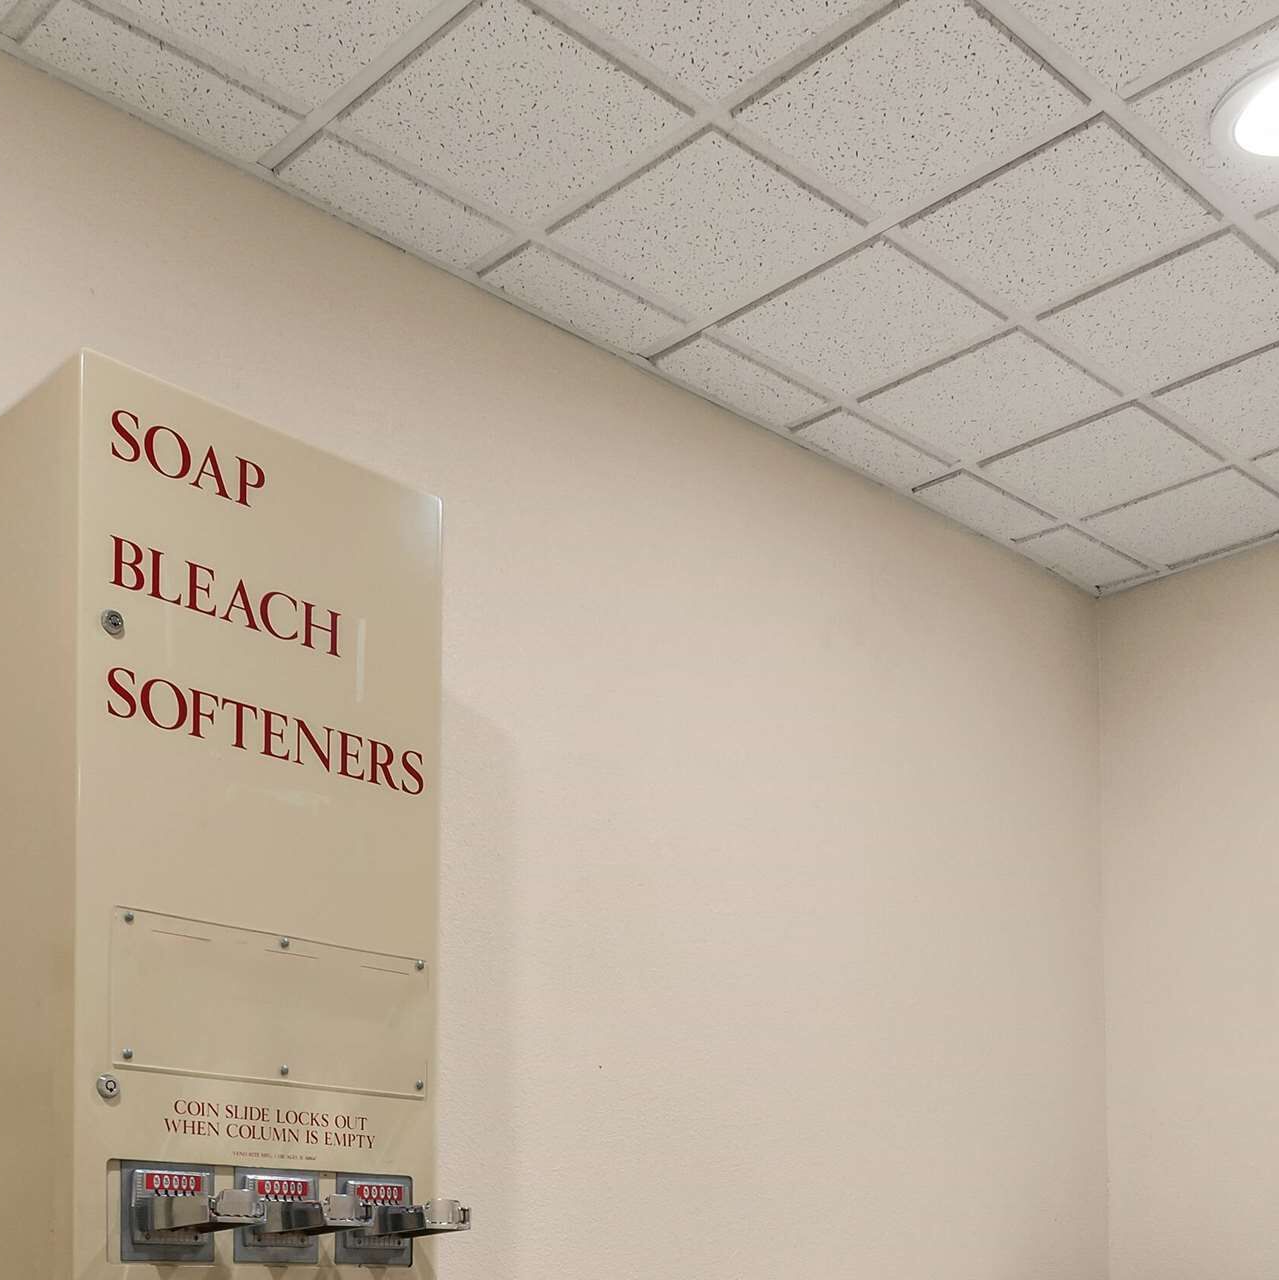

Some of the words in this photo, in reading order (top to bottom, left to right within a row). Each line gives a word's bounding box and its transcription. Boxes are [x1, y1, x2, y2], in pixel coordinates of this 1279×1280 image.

[111, 409, 266, 508] SOAP
[109, 535, 342, 657] BLEACH
[106, 667, 424, 796] SOFTENERS
[164, 1118, 220, 1137] WHEN
[226, 1123, 299, 1144] COLUMN
[305, 1130, 319, 1145] IS
[324, 1131, 376, 1149] EMPTY
[174, 1099, 220, 1118] COIN
[225, 1104, 270, 1122] SLIDE
[276, 1109, 329, 1128] LOCKS
[334, 1114, 368, 1131] OUT
